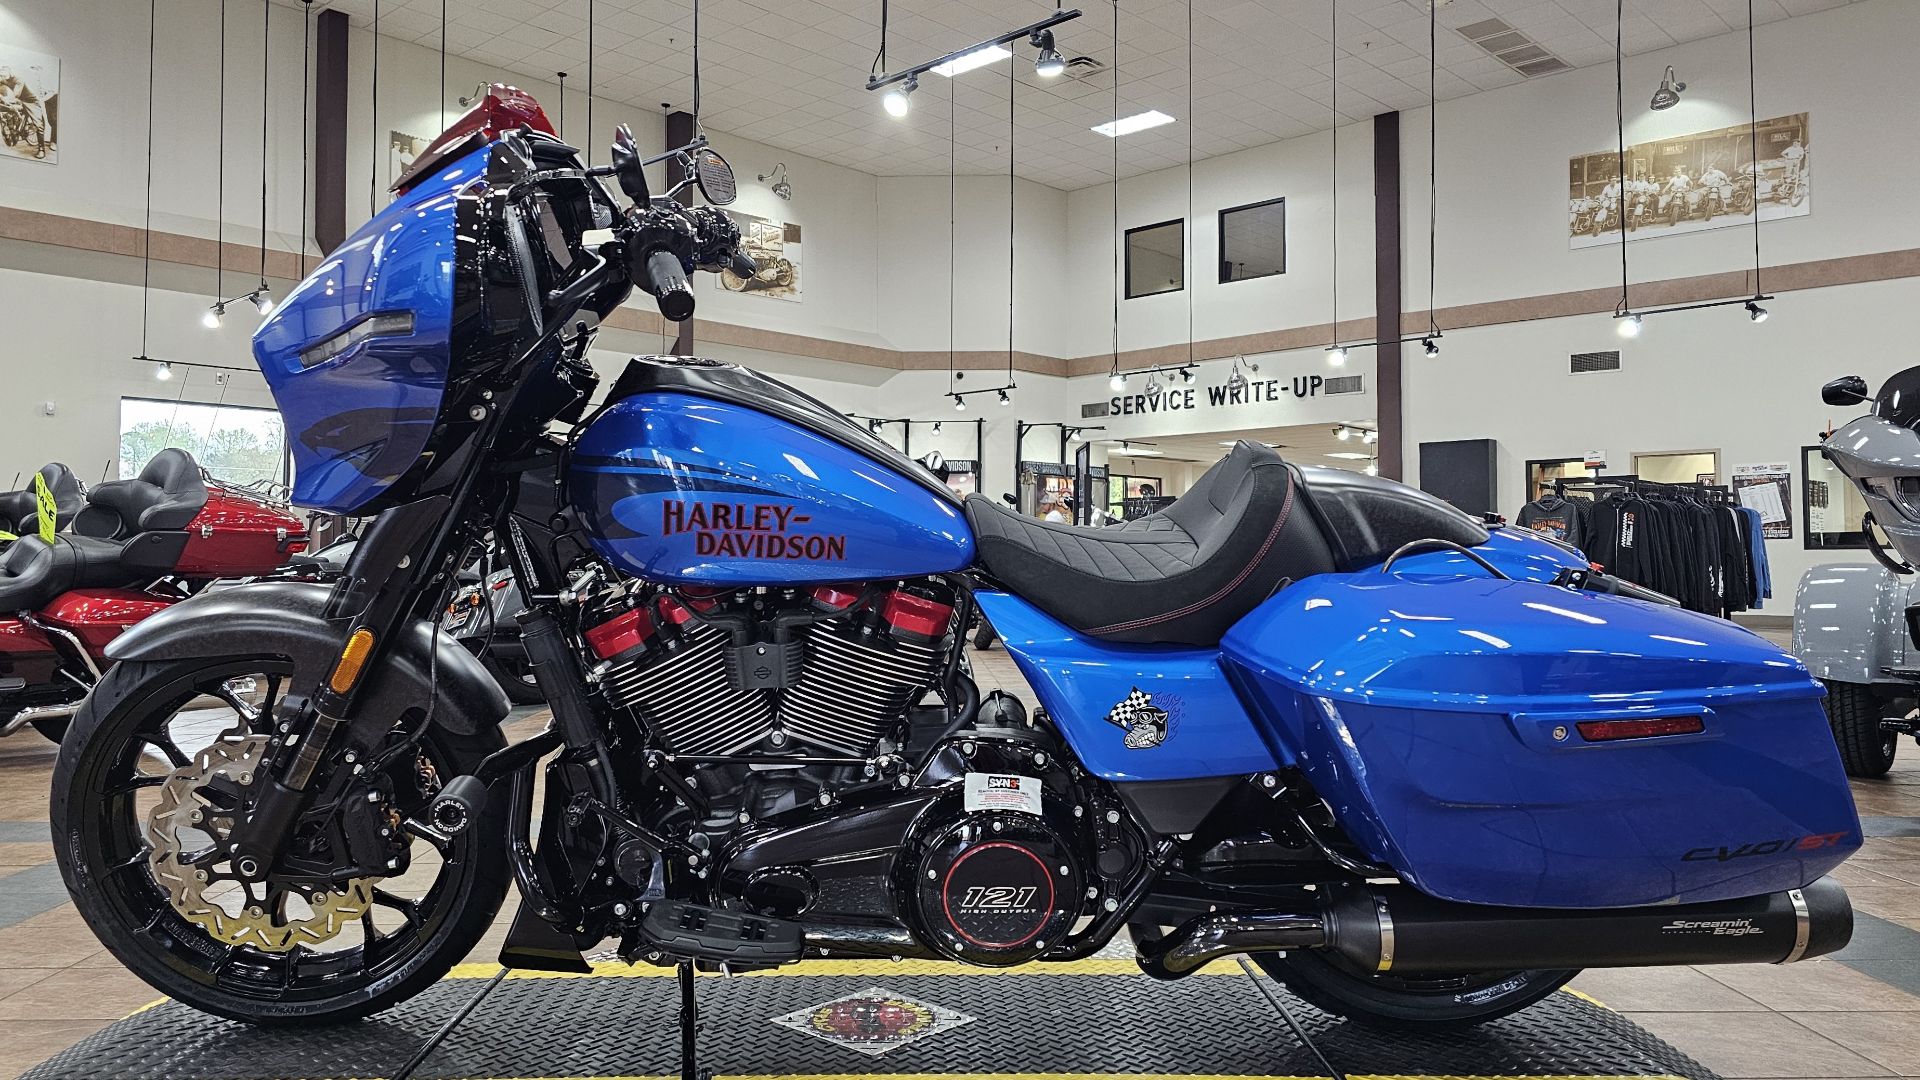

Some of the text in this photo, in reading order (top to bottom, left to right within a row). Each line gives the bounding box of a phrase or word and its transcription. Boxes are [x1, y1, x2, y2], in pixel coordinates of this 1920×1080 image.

[1110, 375, 1323, 416] SERVICE WRITE-UP
[662, 499, 813, 537] HARLEY-
[695, 530, 847, 561] DAVIDSON
[961, 886, 1038, 908] 121
[1713, 925, 1765, 937] Eagle
